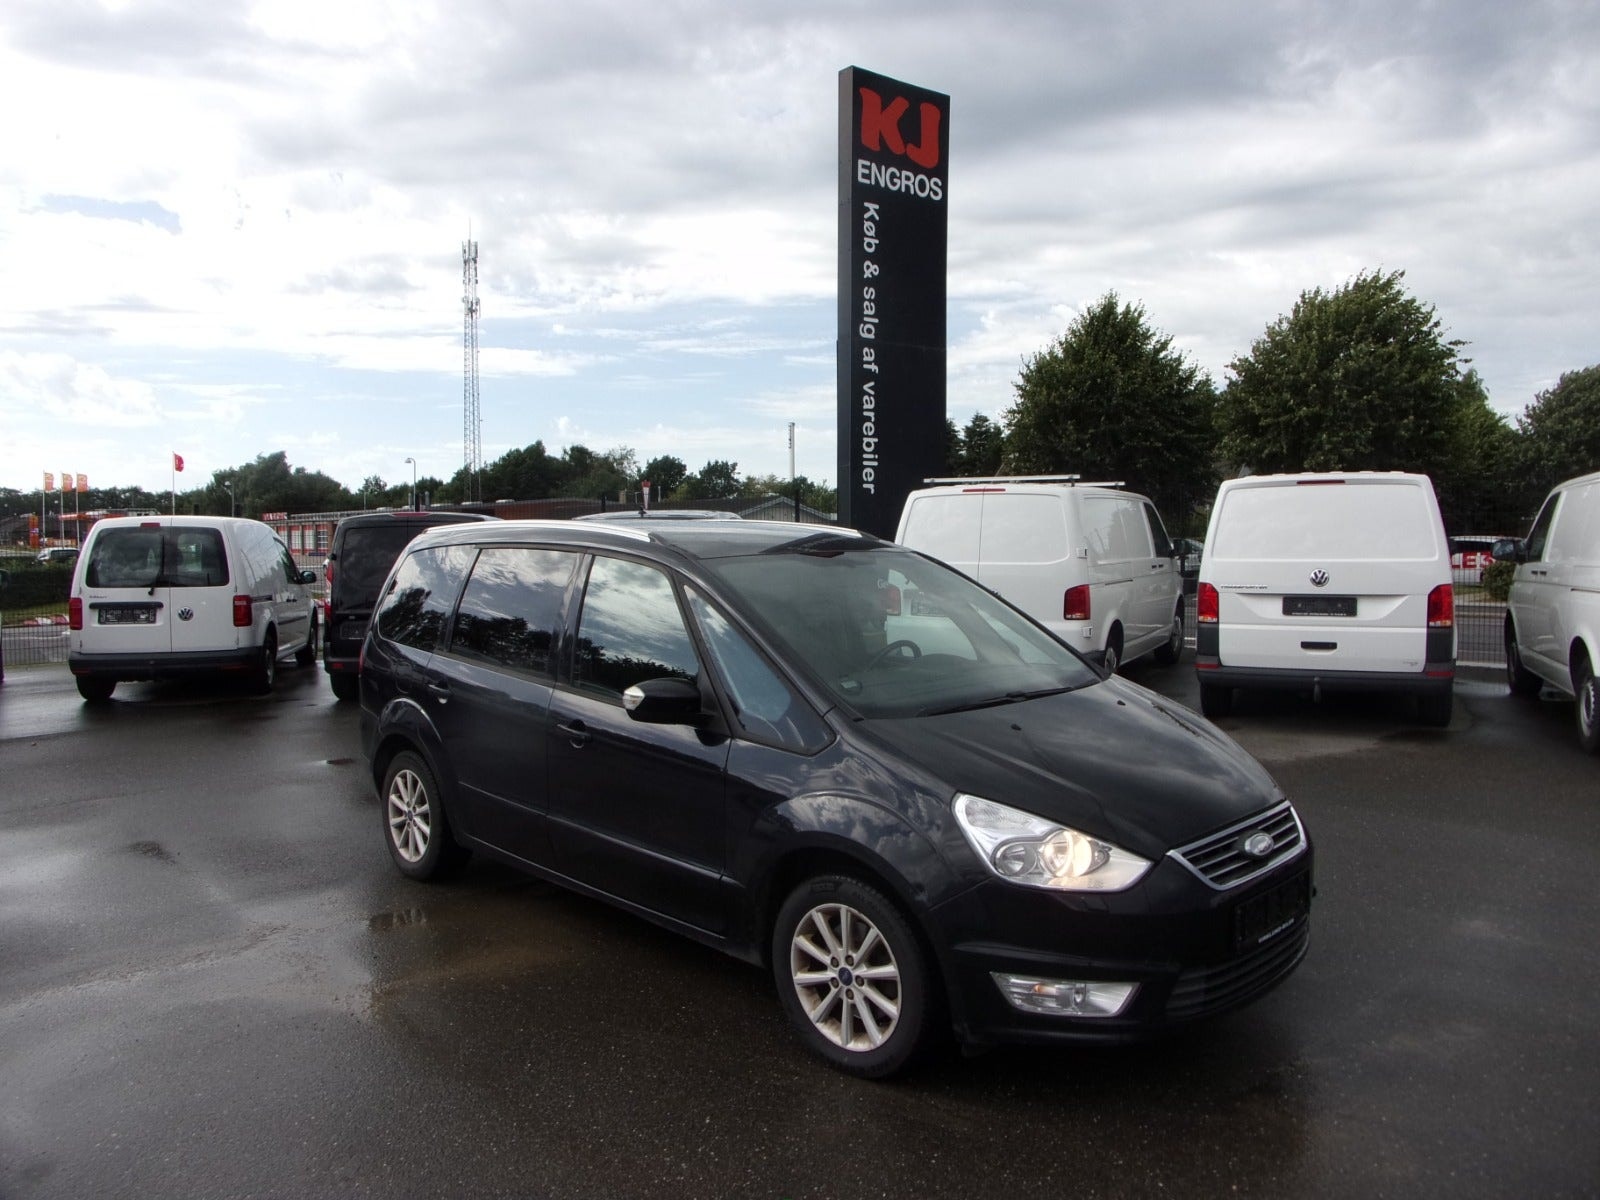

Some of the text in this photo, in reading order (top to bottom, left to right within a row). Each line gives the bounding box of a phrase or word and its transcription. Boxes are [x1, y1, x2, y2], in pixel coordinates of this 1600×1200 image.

[859, 87, 941, 169] KJ
[857, 159, 943, 201] ENGROS
[859, 201, 880, 495] Køb & salg af varebiler
